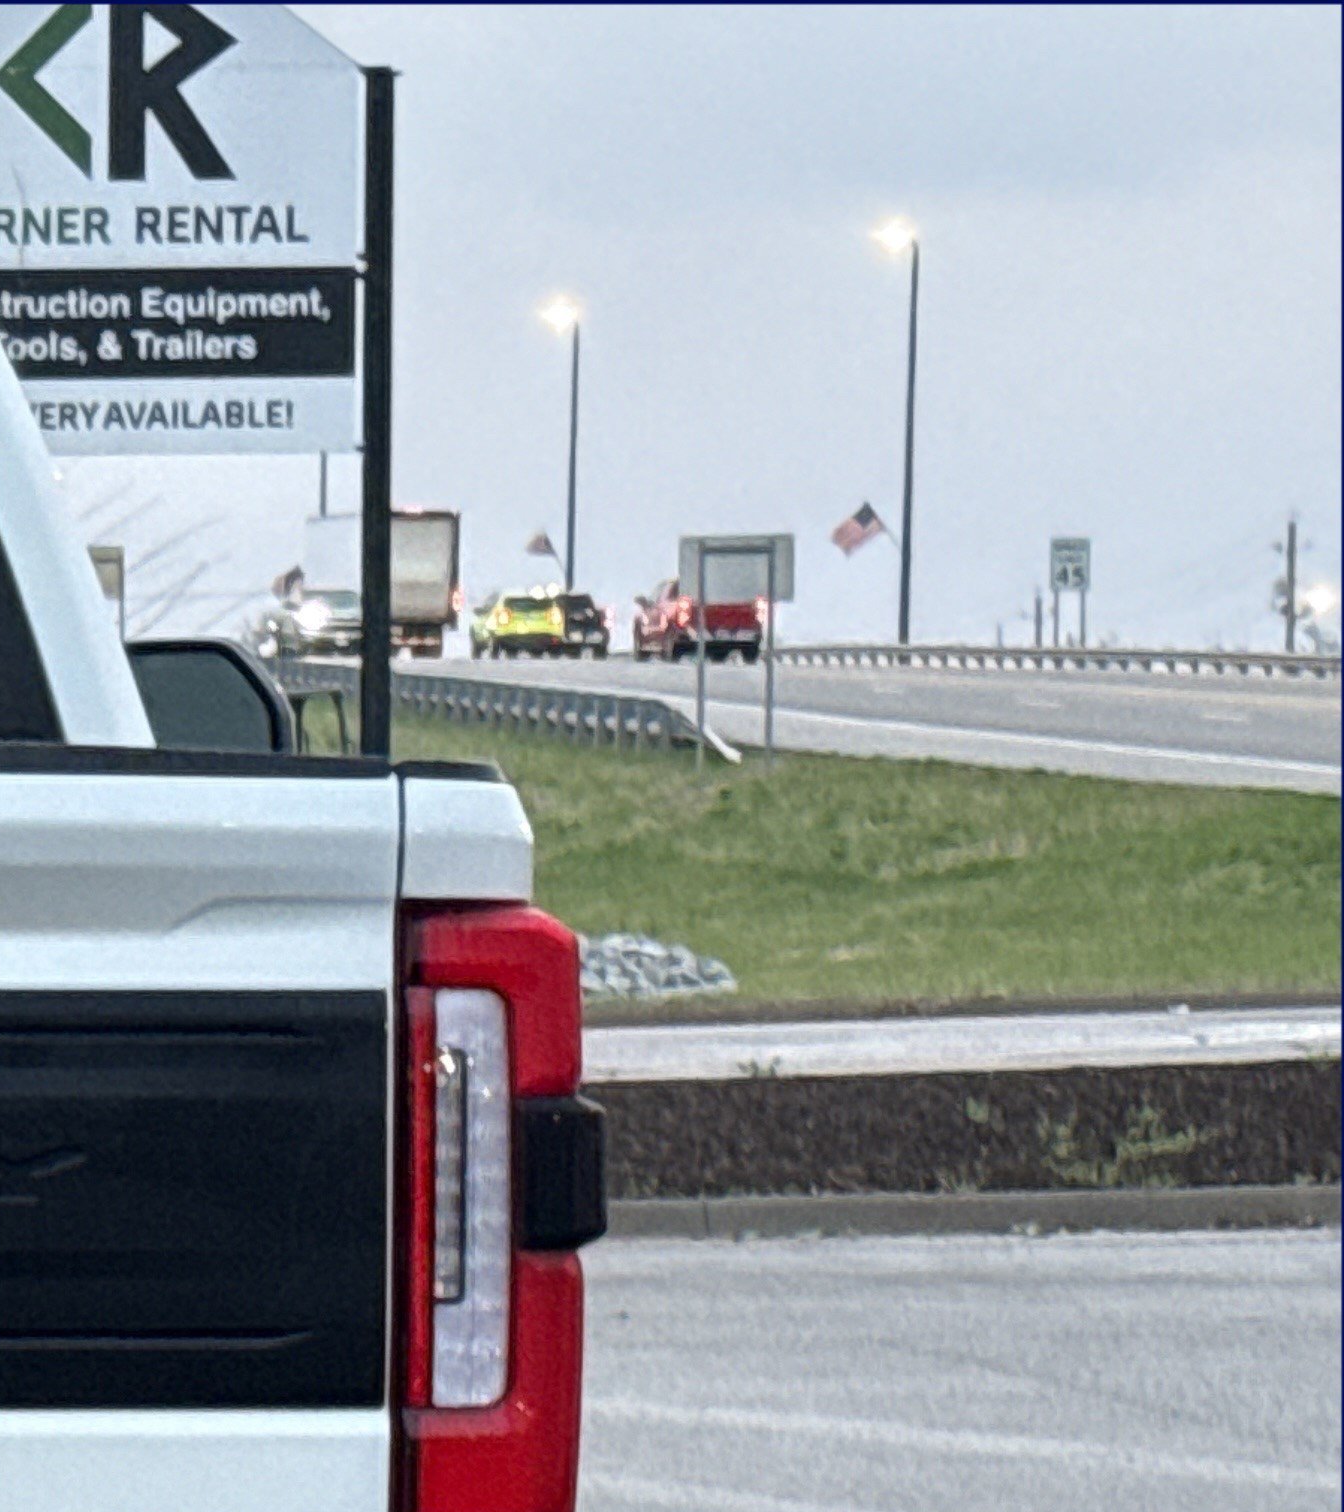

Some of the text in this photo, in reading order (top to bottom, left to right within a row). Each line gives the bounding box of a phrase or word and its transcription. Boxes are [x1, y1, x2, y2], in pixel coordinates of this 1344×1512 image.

[135, 205, 309, 244] RENTAL
[141, 287, 331, 325] Equipment,
[97, 331, 123, 361] &
[131, 329, 258, 361] Trailers
[103, 401, 295, 431] AVAILABLE!
[1056, 564, 1086, 587] 45
